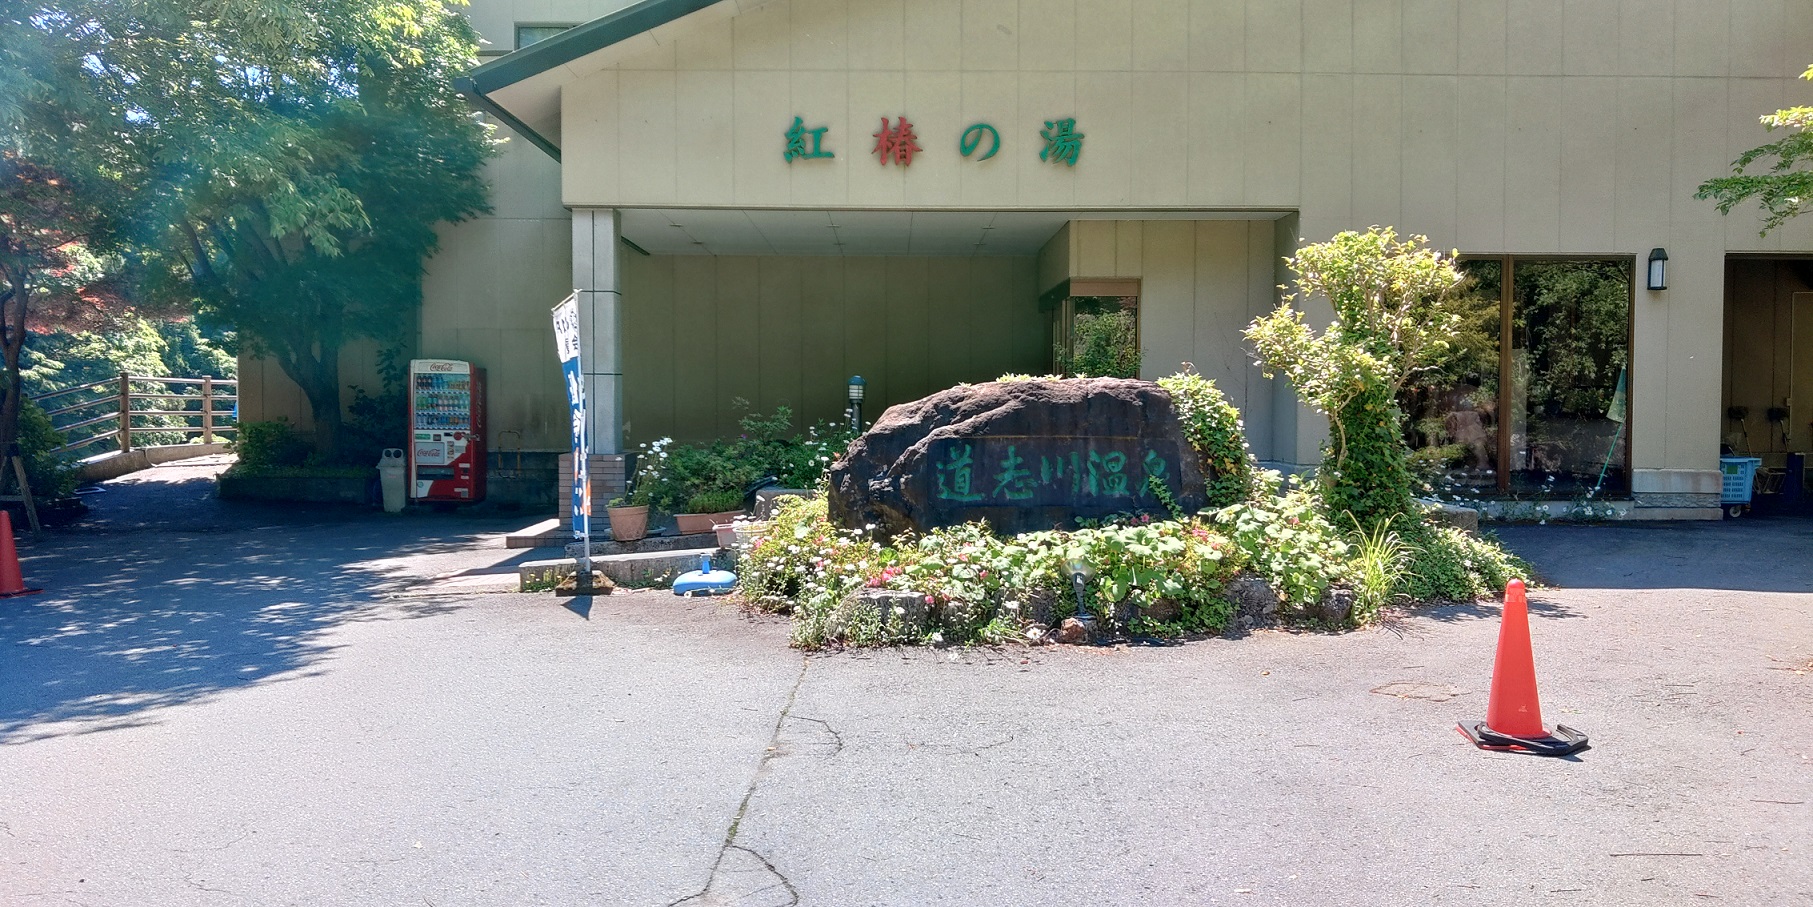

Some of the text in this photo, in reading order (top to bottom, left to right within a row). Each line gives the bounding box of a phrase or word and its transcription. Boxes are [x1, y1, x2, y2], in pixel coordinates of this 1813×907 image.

[783, 116, 1085, 167] 紅椿の湯
[936, 444, 1170, 501] 道志川温泉
